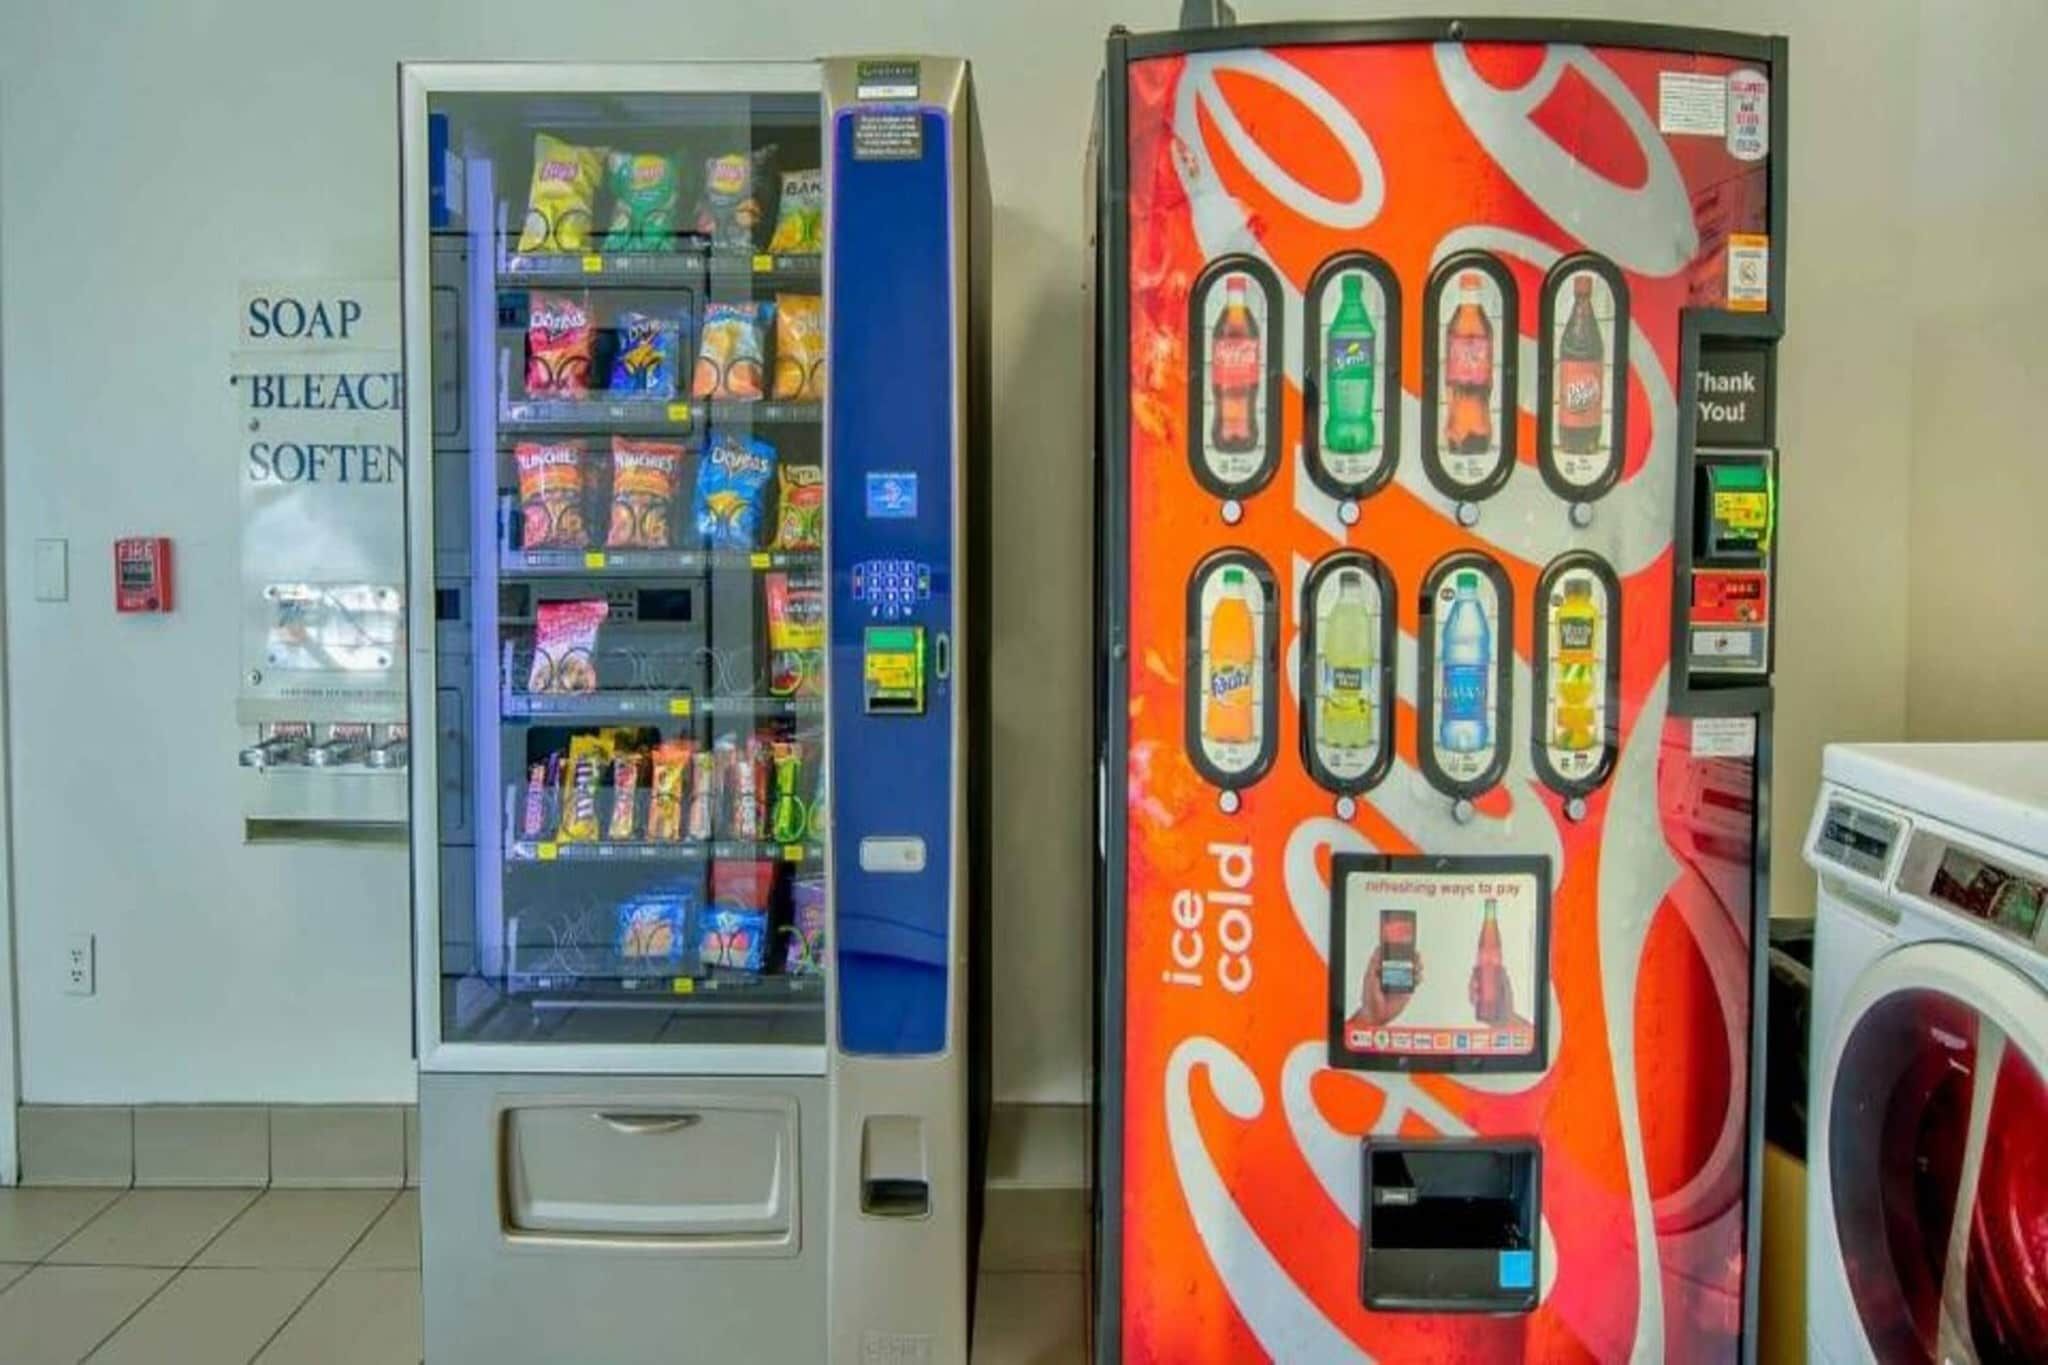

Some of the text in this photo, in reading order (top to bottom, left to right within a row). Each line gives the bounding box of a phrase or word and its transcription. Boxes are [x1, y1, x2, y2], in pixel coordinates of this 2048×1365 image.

[249, 298, 361, 338] SOAP
[1696, 370, 1755, 393] Thank
[1698, 401, 1746, 422] You!
[249, 442, 404, 483] SOFTEN
[1365, 880, 1521, 899] refreshing ways to pay
[1161, 888, 1204, 987] ice
[1206, 842, 1254, 994] cold
